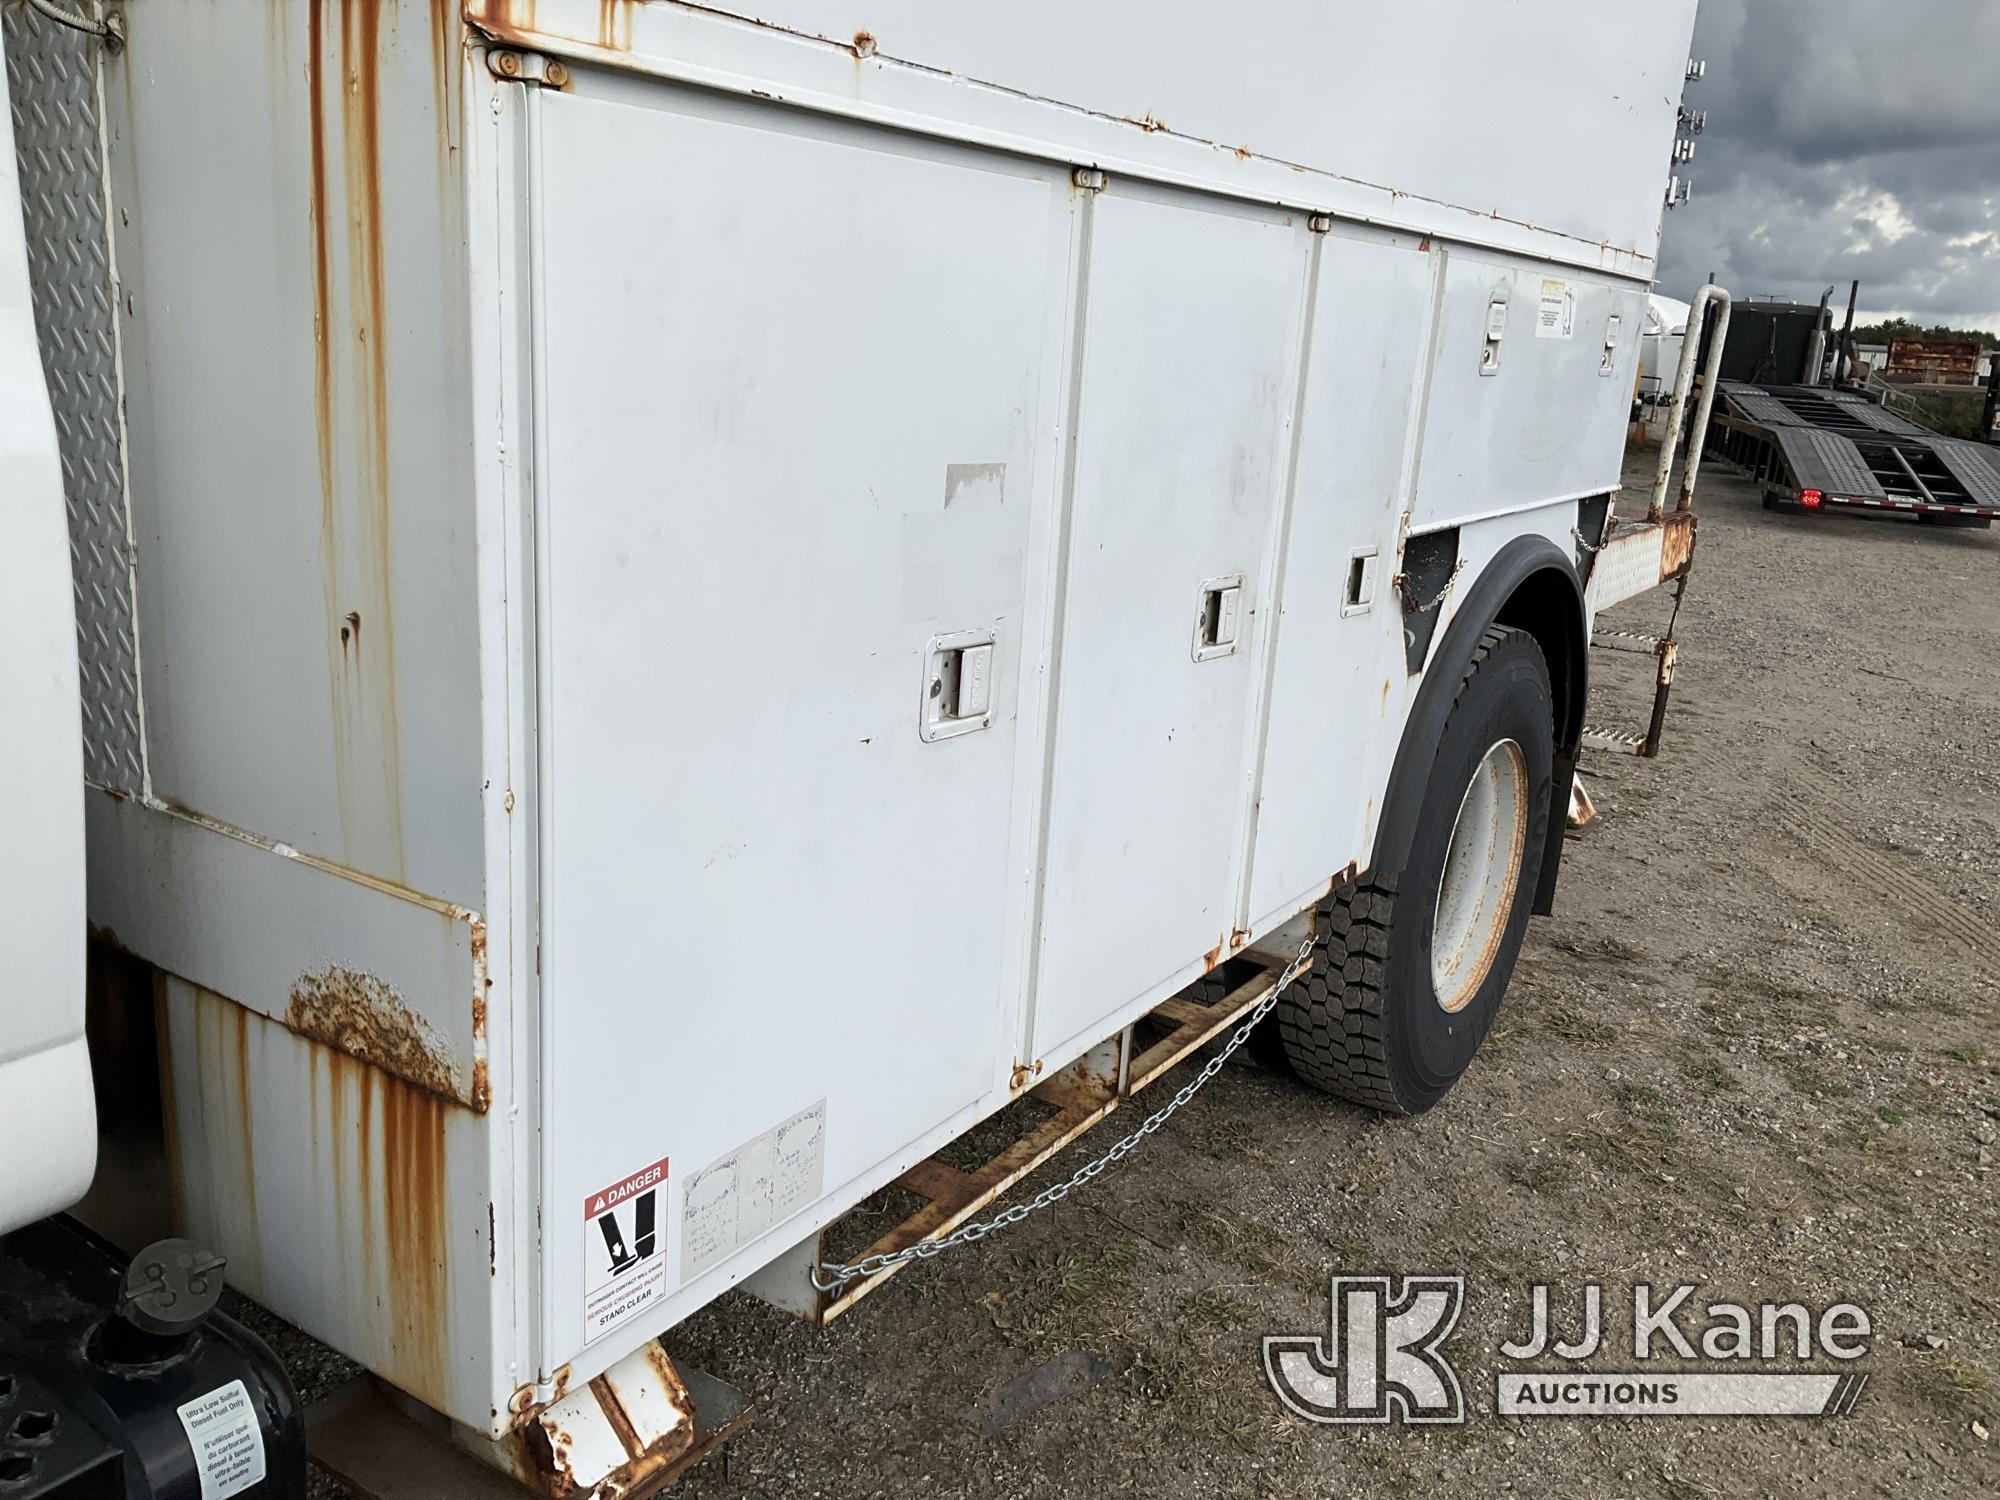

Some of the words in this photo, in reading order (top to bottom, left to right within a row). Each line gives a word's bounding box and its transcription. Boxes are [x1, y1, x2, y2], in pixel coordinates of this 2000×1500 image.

[608, 1167, 661, 1204] DANGER
[587, 1301, 613, 1321] SERIOUS
[614, 1284, 643, 1305] CRUSHING
[644, 1271, 663, 1287] INJURY
[588, 1290, 615, 1309] OUTRIGGER
[616, 1277, 637, 1293] CONTACT
[637, 1271, 648, 1281] WILL
[648, 1261, 663, 1274] CAUSE
[600, 1305, 626, 1326] STAND
[627, 1288, 652, 1310] CLEAR
[186, 1407, 204, 1419] Ultra
[204, 1400, 219, 1411] Low
[219, 1389, 240, 1403] Sulfur
[191, 1415, 213, 1429] Diesel
[213, 1407, 229, 1418] Fuel
[229, 1399, 244, 1411] Only
[204, 1430, 234, 1450] N'utiliser
[235, 1424, 249, 1436] que
[208, 1451, 217, 1460] du
[218, 1434, 250, 1454] carburant
[207, 1456, 227, 1472] diesel
[234, 1443, 255, 1458] teneur
[214, 1456, 251, 1479] ultra-faible
[218, 1478, 227, 1487] en
[228, 1467, 249, 1483] soufre
